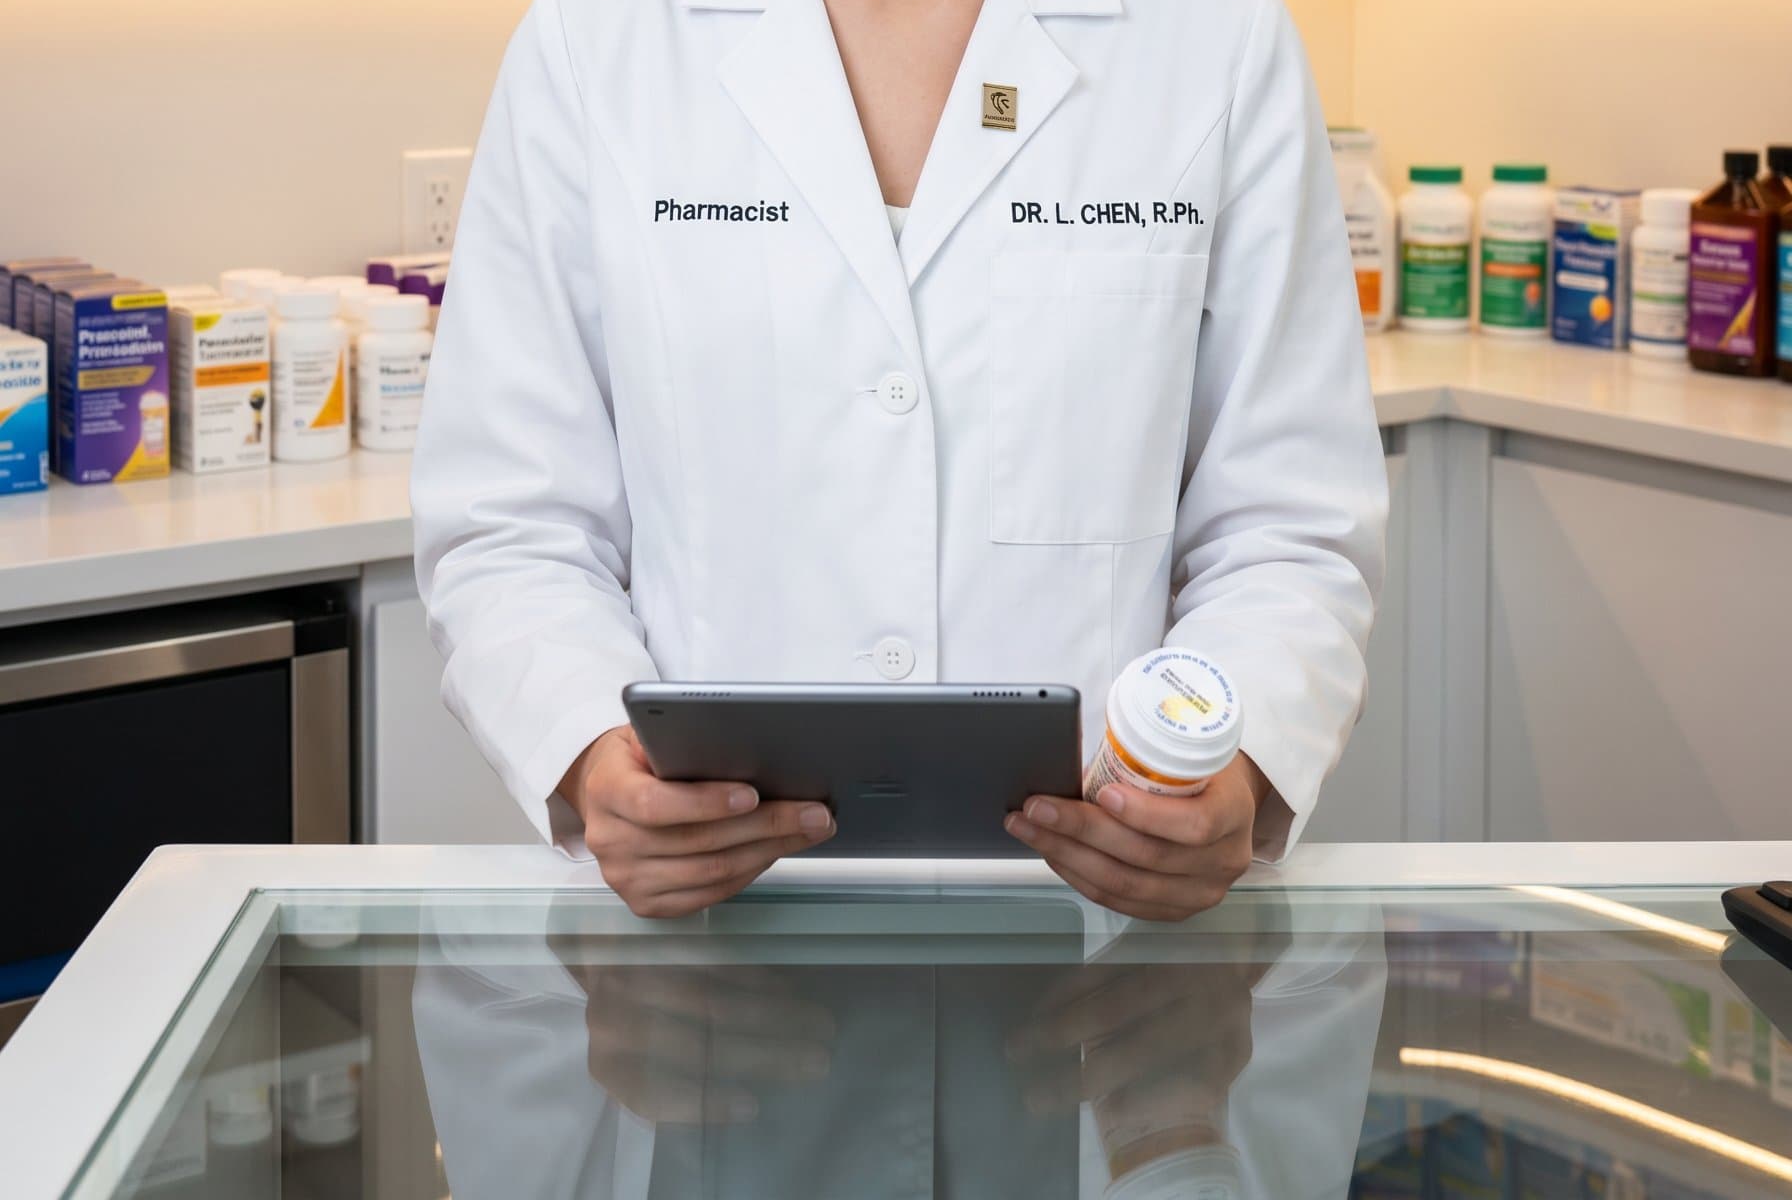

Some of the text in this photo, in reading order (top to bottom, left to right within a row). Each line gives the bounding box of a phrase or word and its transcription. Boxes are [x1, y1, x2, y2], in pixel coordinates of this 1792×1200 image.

[654, 198, 790, 222] Pharmacist
[1011, 201, 1205, 228] DR. L. CHEN, R.Ph.
